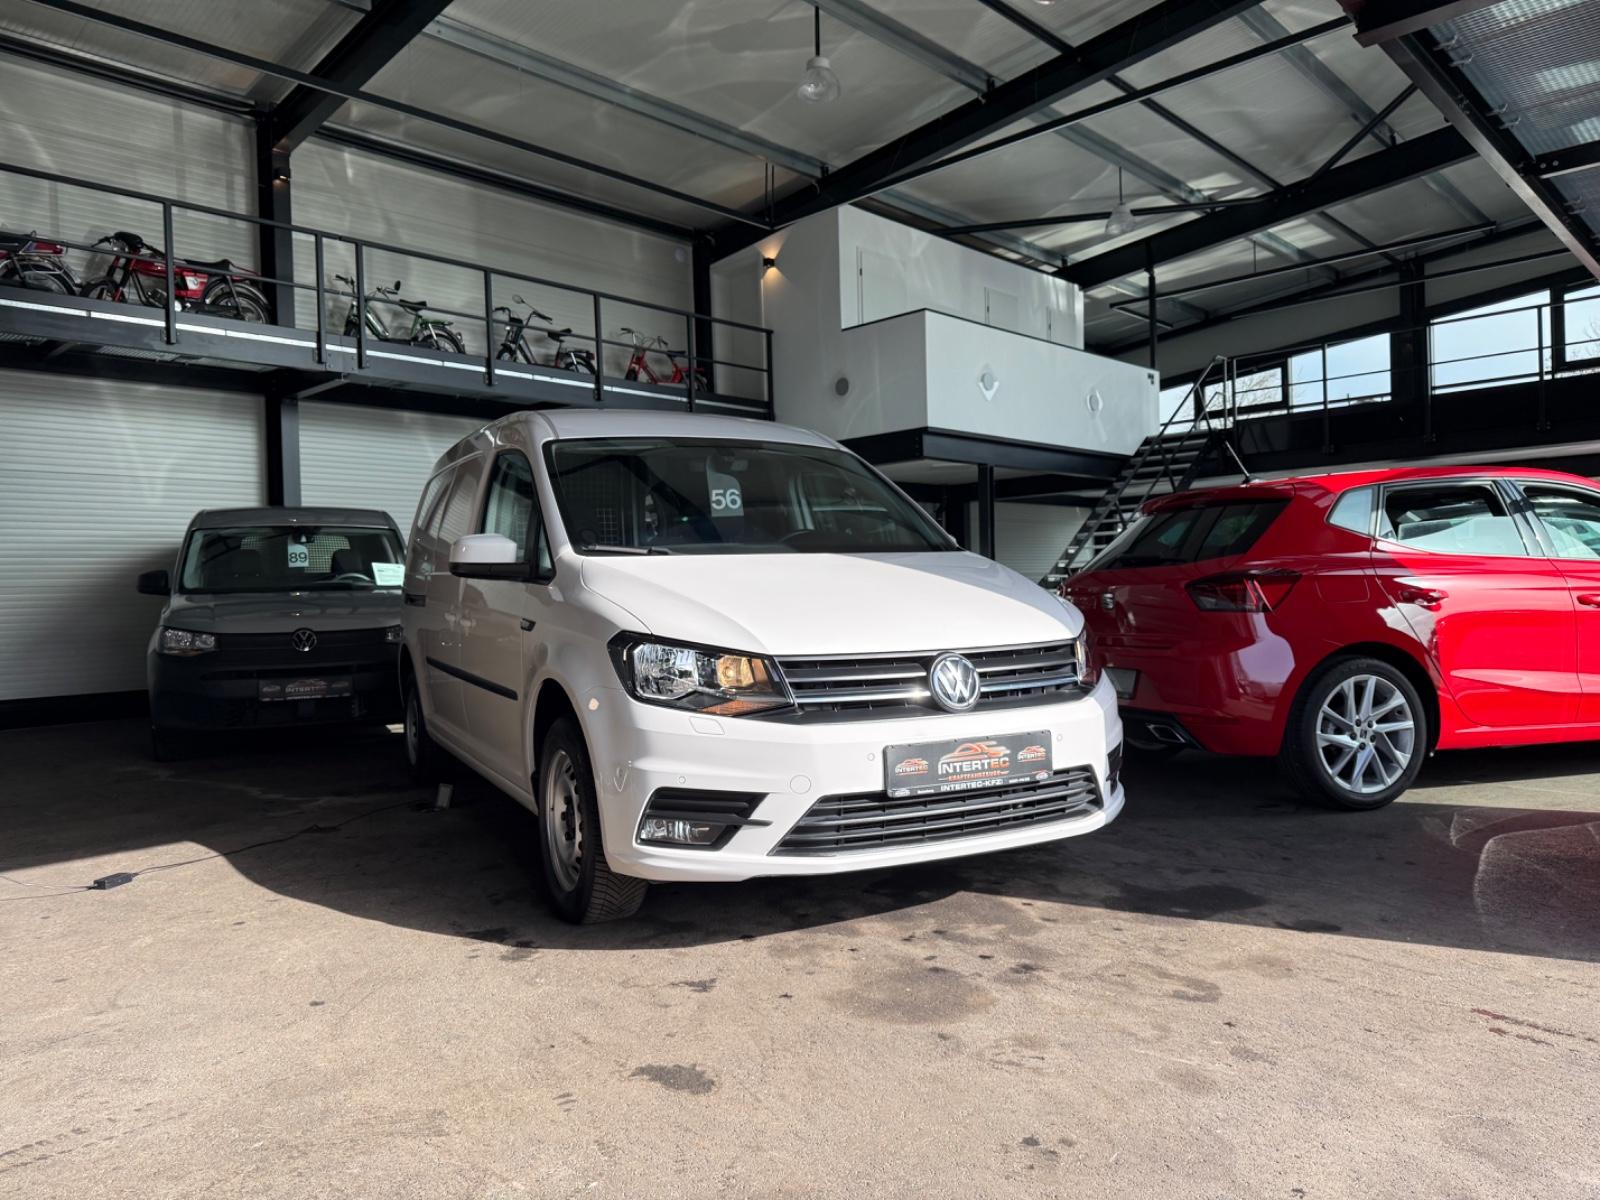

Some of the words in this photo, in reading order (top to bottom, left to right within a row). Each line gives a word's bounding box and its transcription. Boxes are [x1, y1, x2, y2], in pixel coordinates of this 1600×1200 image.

[711, 488, 742, 510] 56
[289, 551, 308, 563] 89
[938, 756, 1010, 775] INTERTEC
[940, 779, 1004, 791] INTERTEC-KFZ
